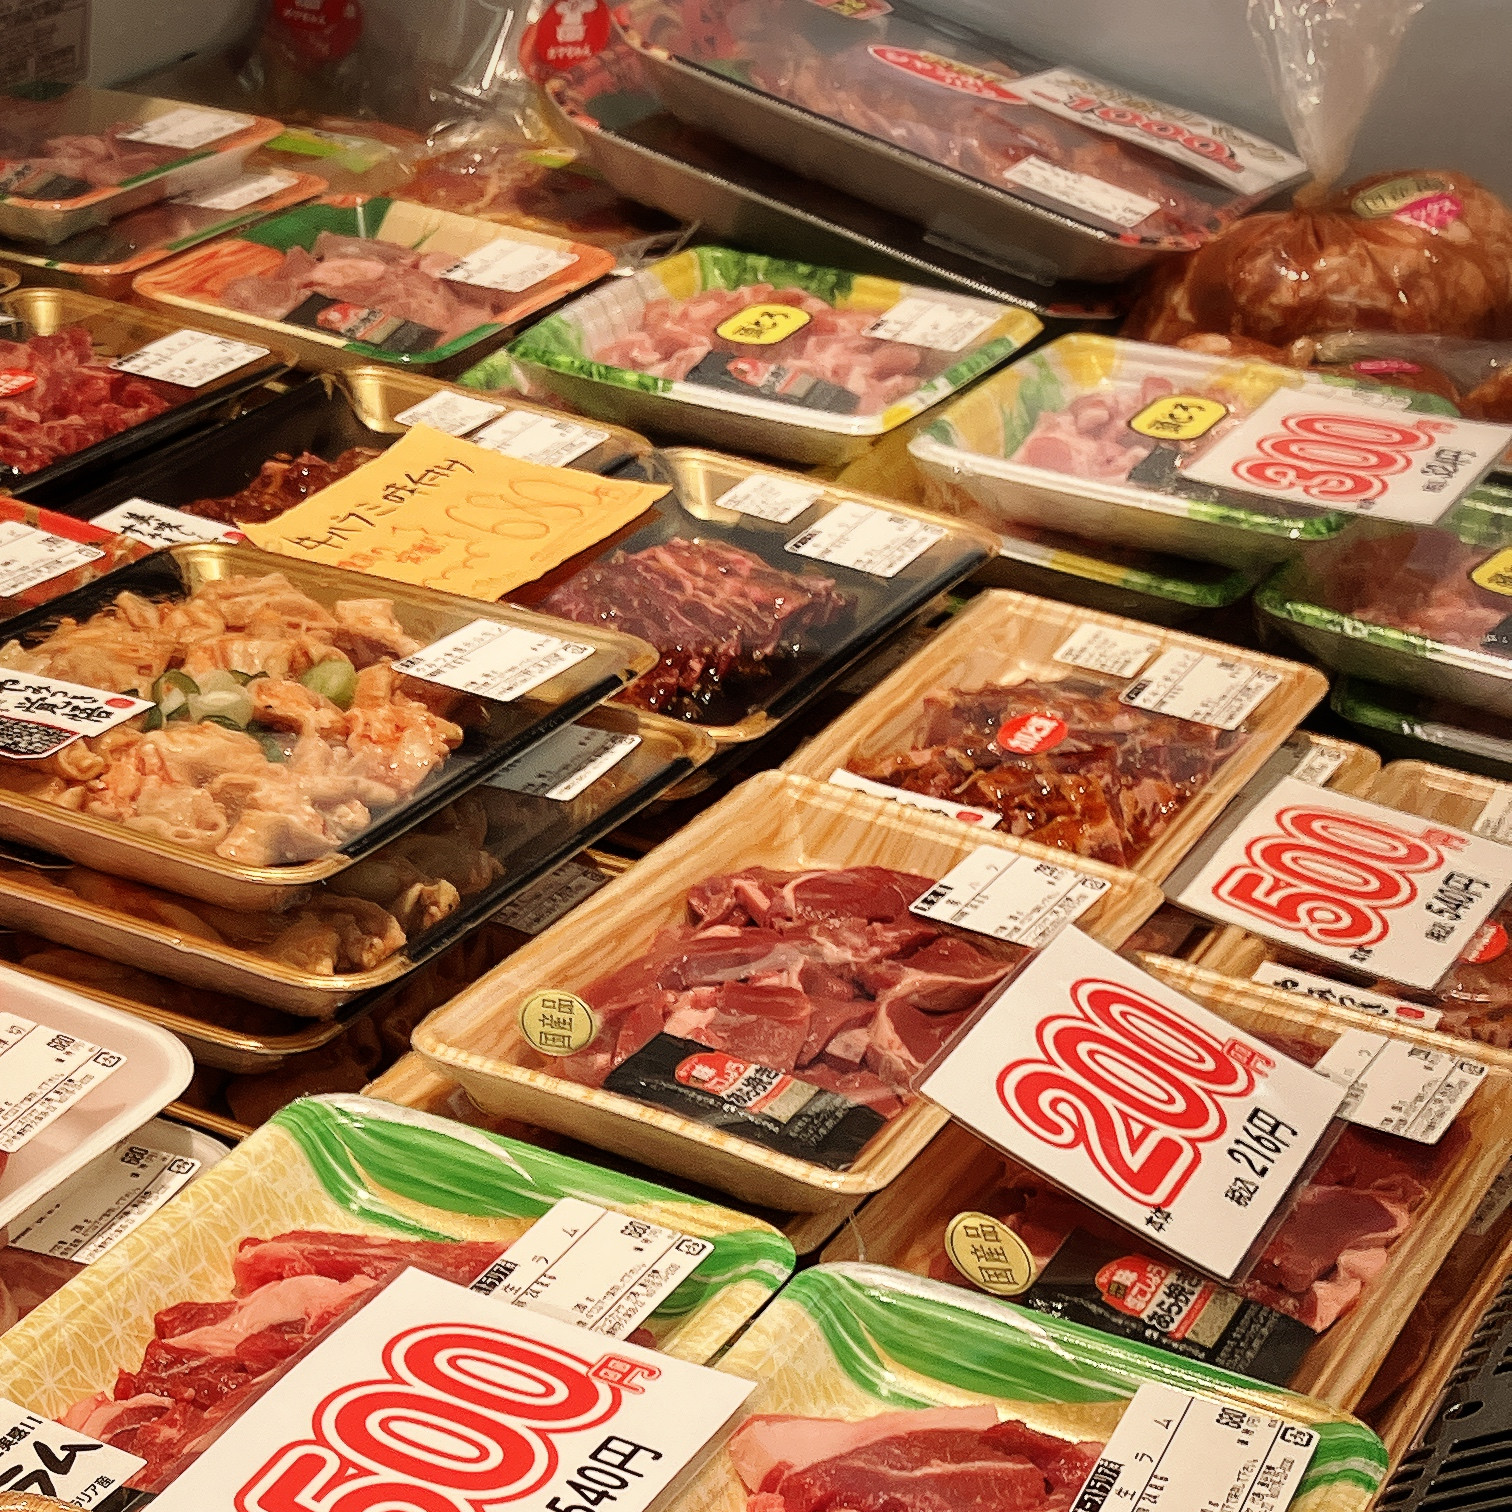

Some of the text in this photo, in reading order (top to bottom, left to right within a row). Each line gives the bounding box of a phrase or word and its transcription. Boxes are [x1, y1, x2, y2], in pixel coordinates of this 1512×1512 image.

[1425, 870, 1491, 920] 540円
[1237, 1105, 1301, 1179] 216円
[1114, 1418, 1173, 1501] 生ラム
